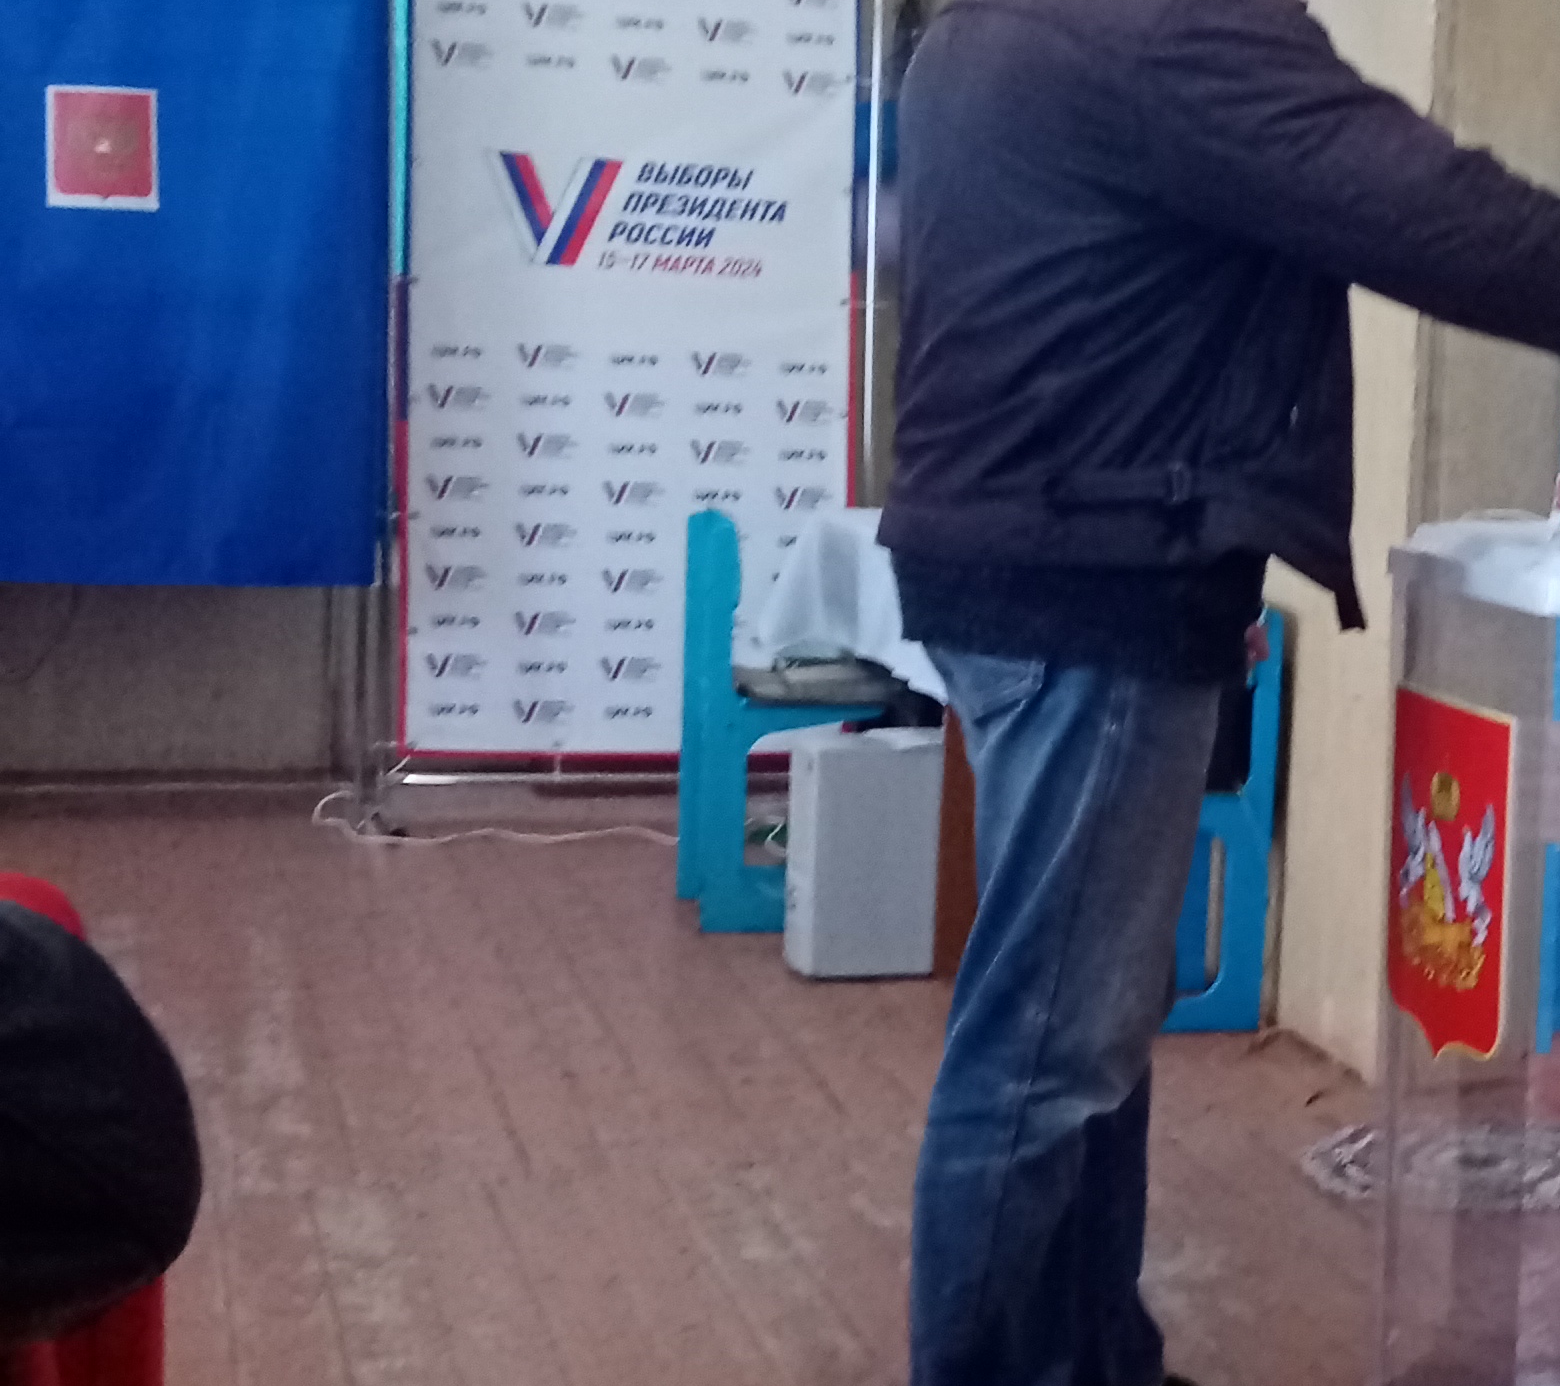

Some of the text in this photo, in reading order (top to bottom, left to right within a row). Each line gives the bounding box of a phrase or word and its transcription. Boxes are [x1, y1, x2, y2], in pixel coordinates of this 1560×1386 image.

[634, 160, 754, 191] ВЫБОРЫ
[622, 190, 788, 225] ПРЕЗИДЕНТА
[607, 220, 716, 249] РОССИИ
[652, 253, 717, 275] МАРТА
[717, 255, 763, 278] 2024
